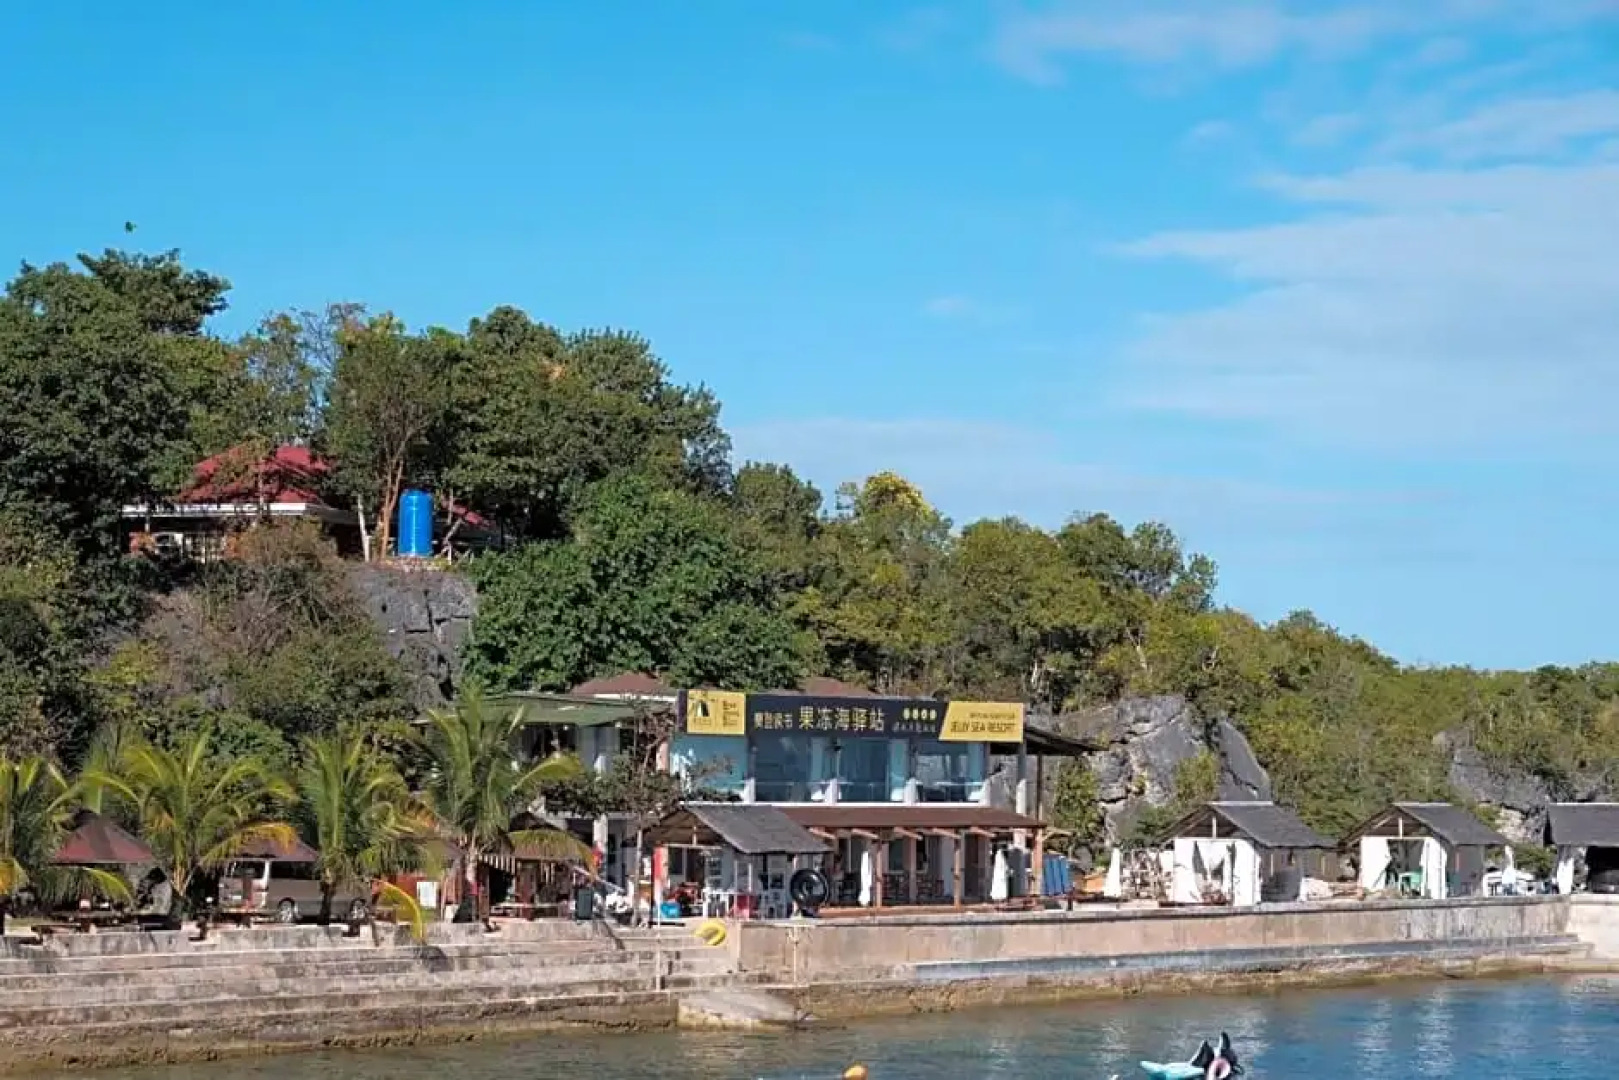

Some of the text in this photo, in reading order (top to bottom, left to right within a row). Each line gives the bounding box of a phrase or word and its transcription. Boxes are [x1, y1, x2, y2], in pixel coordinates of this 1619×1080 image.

[951, 721, 1016, 732] JELLY SEA RESORT
